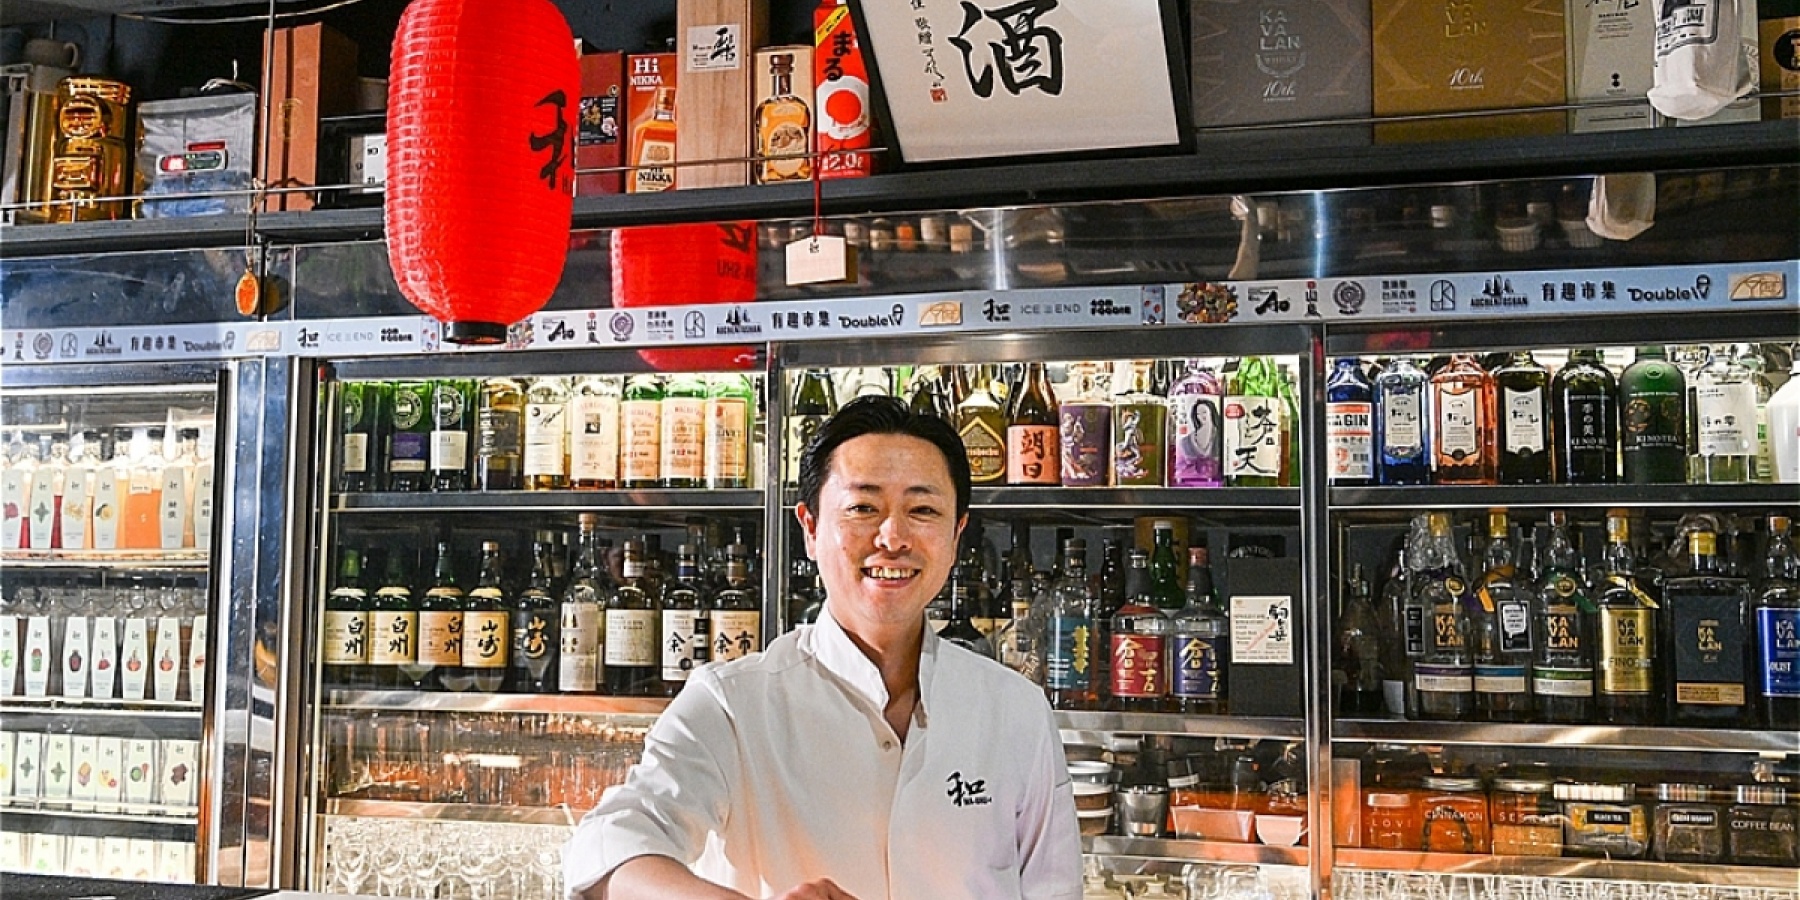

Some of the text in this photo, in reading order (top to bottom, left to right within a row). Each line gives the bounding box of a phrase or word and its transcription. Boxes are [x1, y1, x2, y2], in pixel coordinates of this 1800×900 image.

[1260, 36, 1300, 49] LAN
[948, 0, 1063, 98] 酒
[822, 29, 853, 82] まる
[633, 57, 660, 74] Hi
[629, 75, 664, 86] NIKKA
[638, 171, 673, 183] NIKKA
[1020, 303, 1081, 315] ICE END
[353, 331, 374, 342] END
[1343, 414, 1369, 426] GIN
[1435, 615, 1456, 626] KA
[1547, 616, 1569, 627] KA
[1617, 618, 1636, 628] KA
[1776, 621, 1795, 630] KA
[388, 615, 409, 657] 白州
[1436, 625, 1456, 636] VA
[1548, 627, 1569, 638] VA
[344, 616, 365, 658] 白州
[443, 616, 463, 659] 白州
[714, 630, 755, 656] 余市
[1436, 635, 1465, 647] LAN
[1547, 637, 1579, 648] LAN
[1618, 637, 1645, 646] LAN
[1424, 810, 1484, 822] CINNAMON
[1731, 820, 1796, 832] COFFEE BEAN
